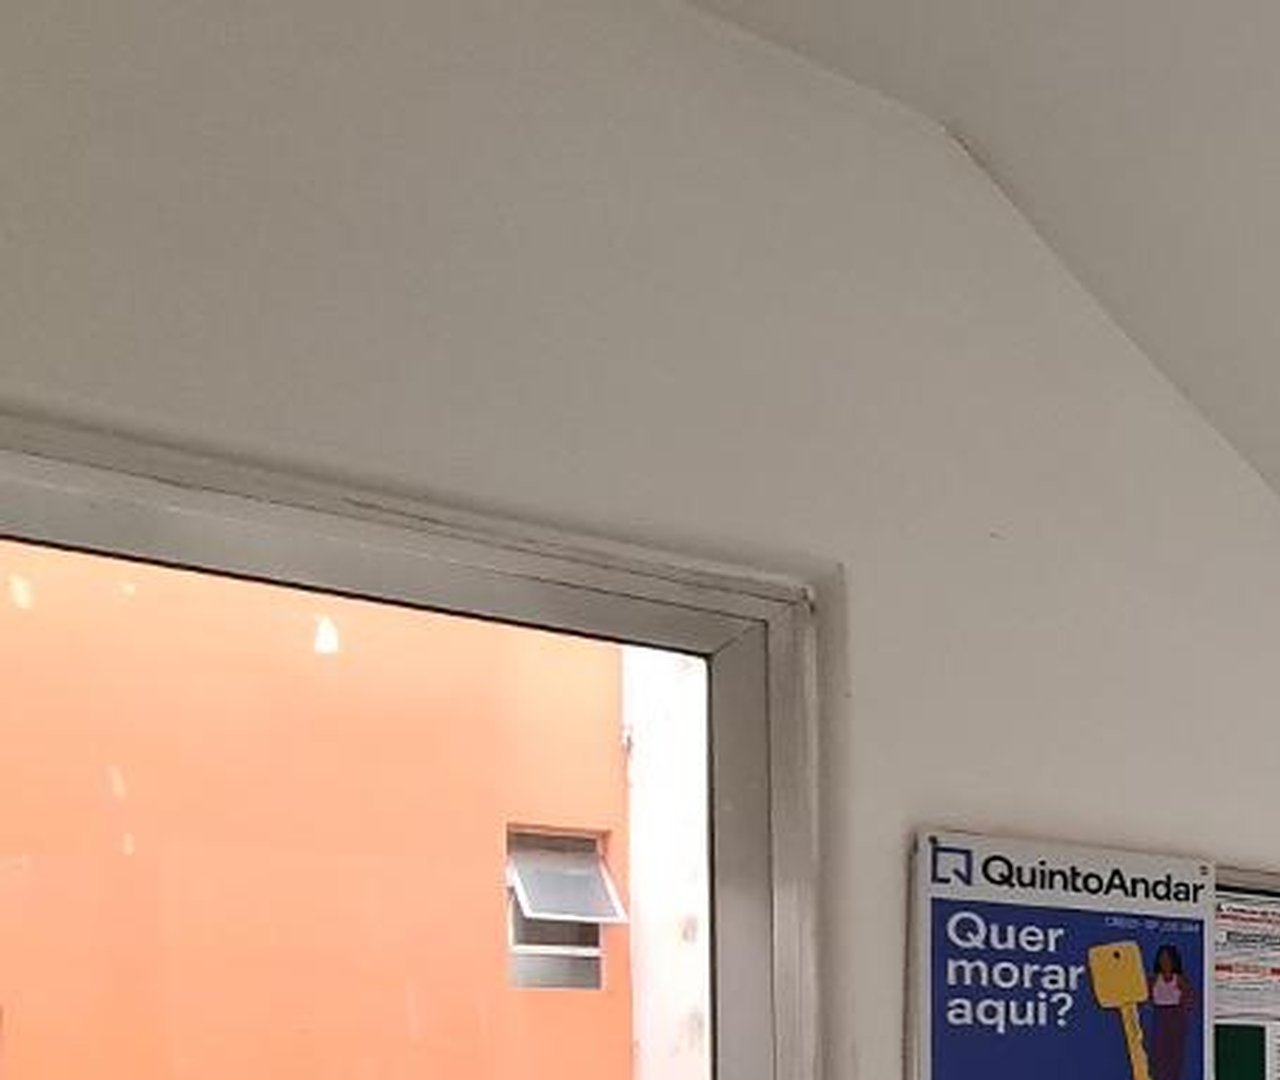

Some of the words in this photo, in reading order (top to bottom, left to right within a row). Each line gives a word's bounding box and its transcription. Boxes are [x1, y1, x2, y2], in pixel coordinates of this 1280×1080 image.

[981, 855, 1205, 903] QuintoAndar
[946, 911, 1064, 952] Quer
[947, 958, 1085, 991] morar
[947, 991, 1074, 1034] aqui?
